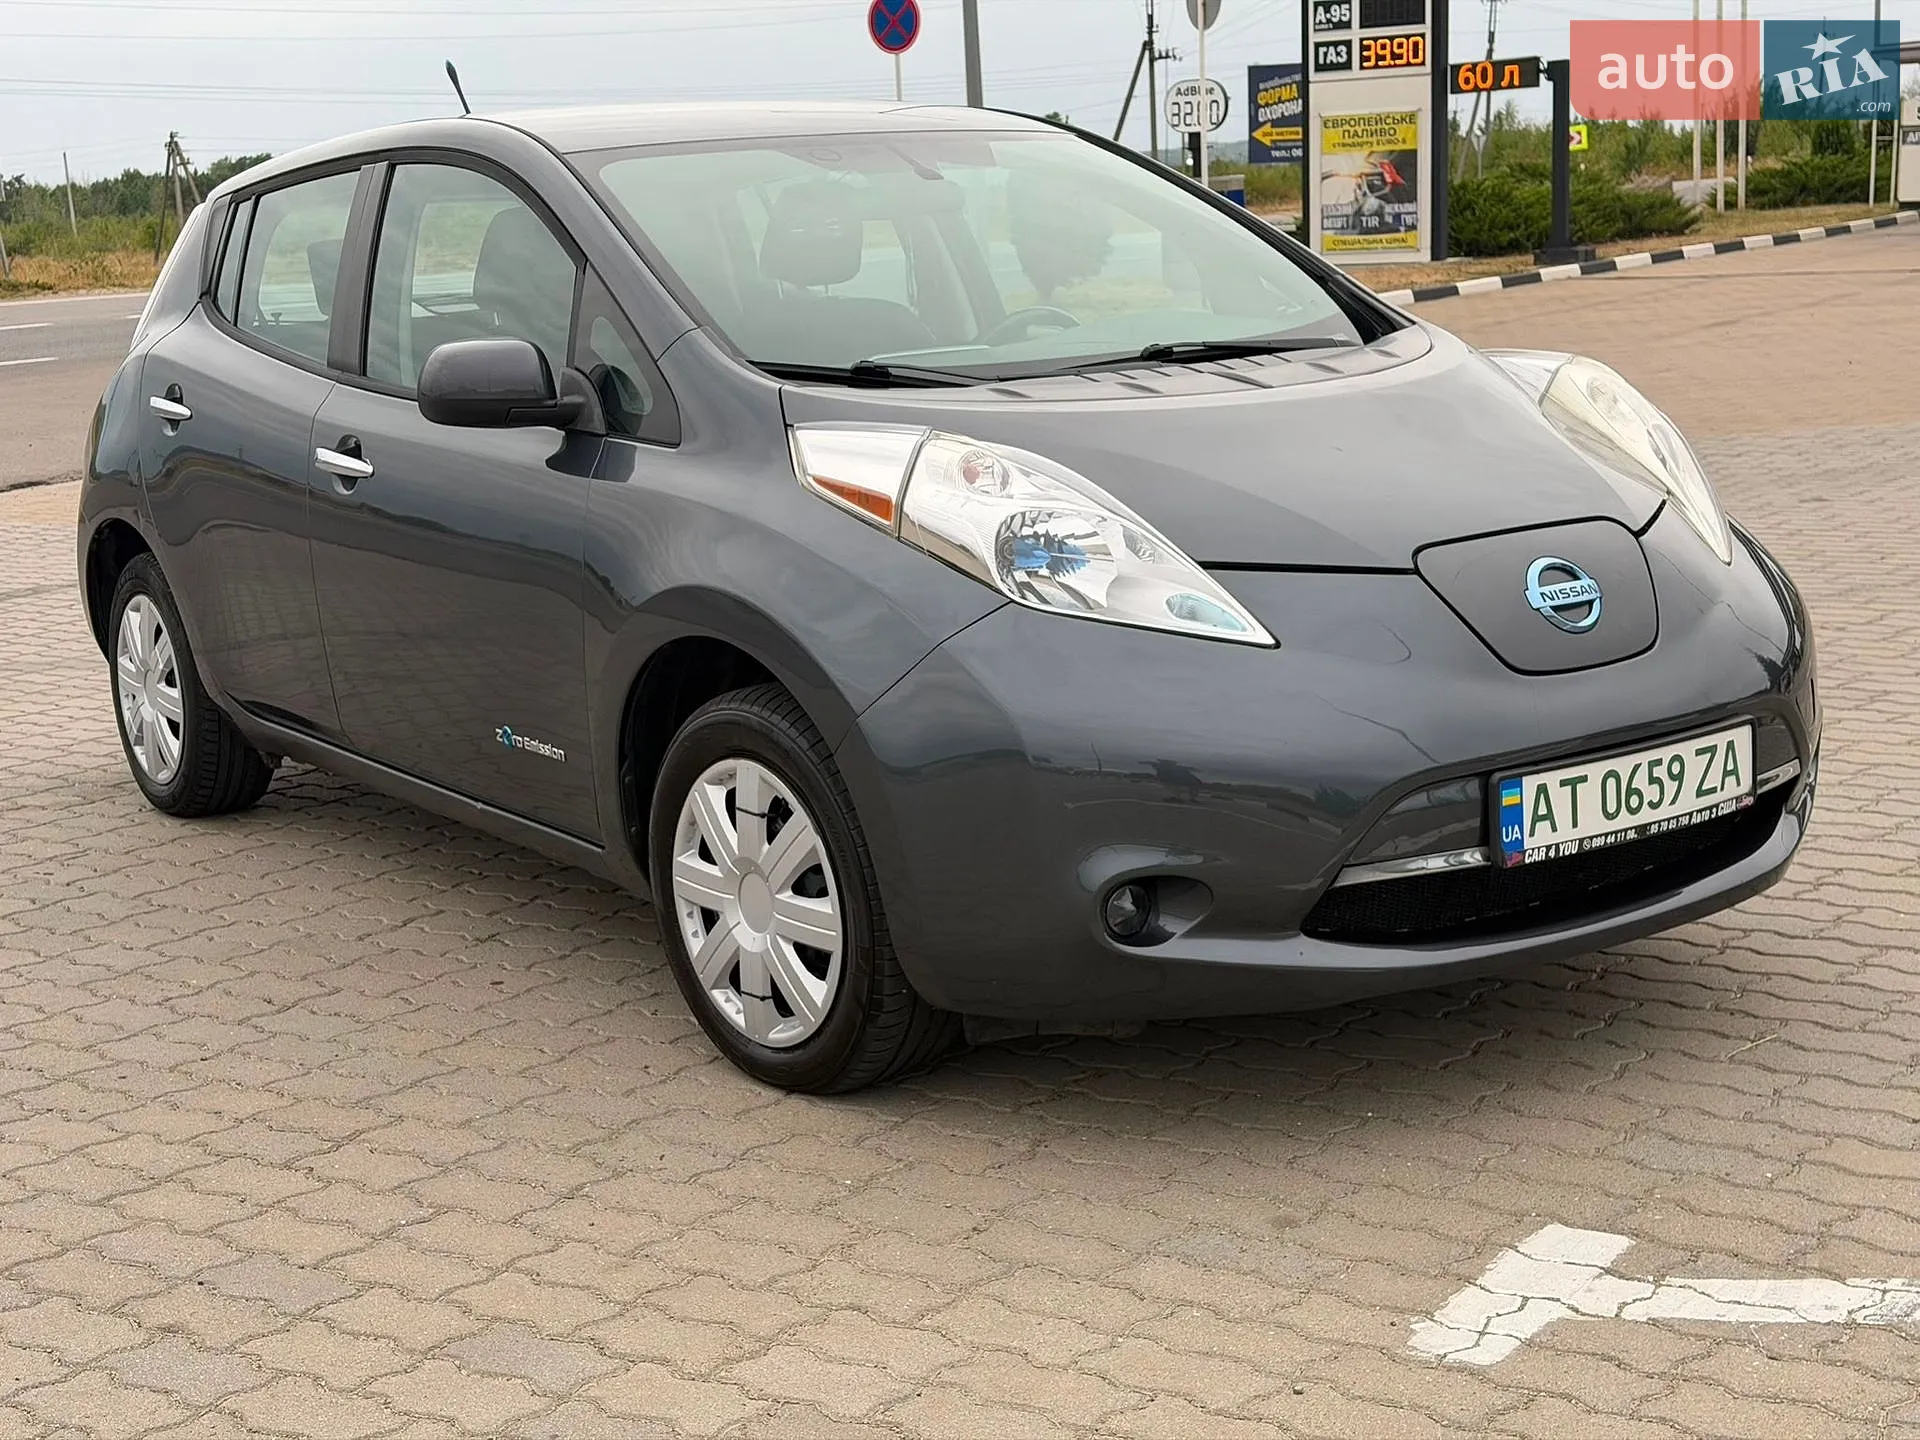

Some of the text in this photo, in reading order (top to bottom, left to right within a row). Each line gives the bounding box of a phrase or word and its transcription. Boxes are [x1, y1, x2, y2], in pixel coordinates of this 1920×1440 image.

[1318, 45, 1348, 65] ГАЗ
[1362, 36, 1424, 67] 39.90
[1458, 61, 1519, 91] 60 л
[1257, 83, 1299, 106] ФОРМА
[1258, 98, 1303, 122] ОХОРОНА
[1323, 113, 1417, 129] ЄВРОПЕЙСЬКЕ
[1342, 126, 1397, 140] ПАЛИВО
[1539, 583, 1598, 603] NISSAN
[523, 737, 566, 762] Emission
[1528, 738, 1742, 839] AT 0659 ZA
[1502, 824, 1521, 843] UA
[1524, 846, 1546, 864] CAR
[1548, 844, 1556, 859] 4
[1558, 840, 1579, 857] YOU
